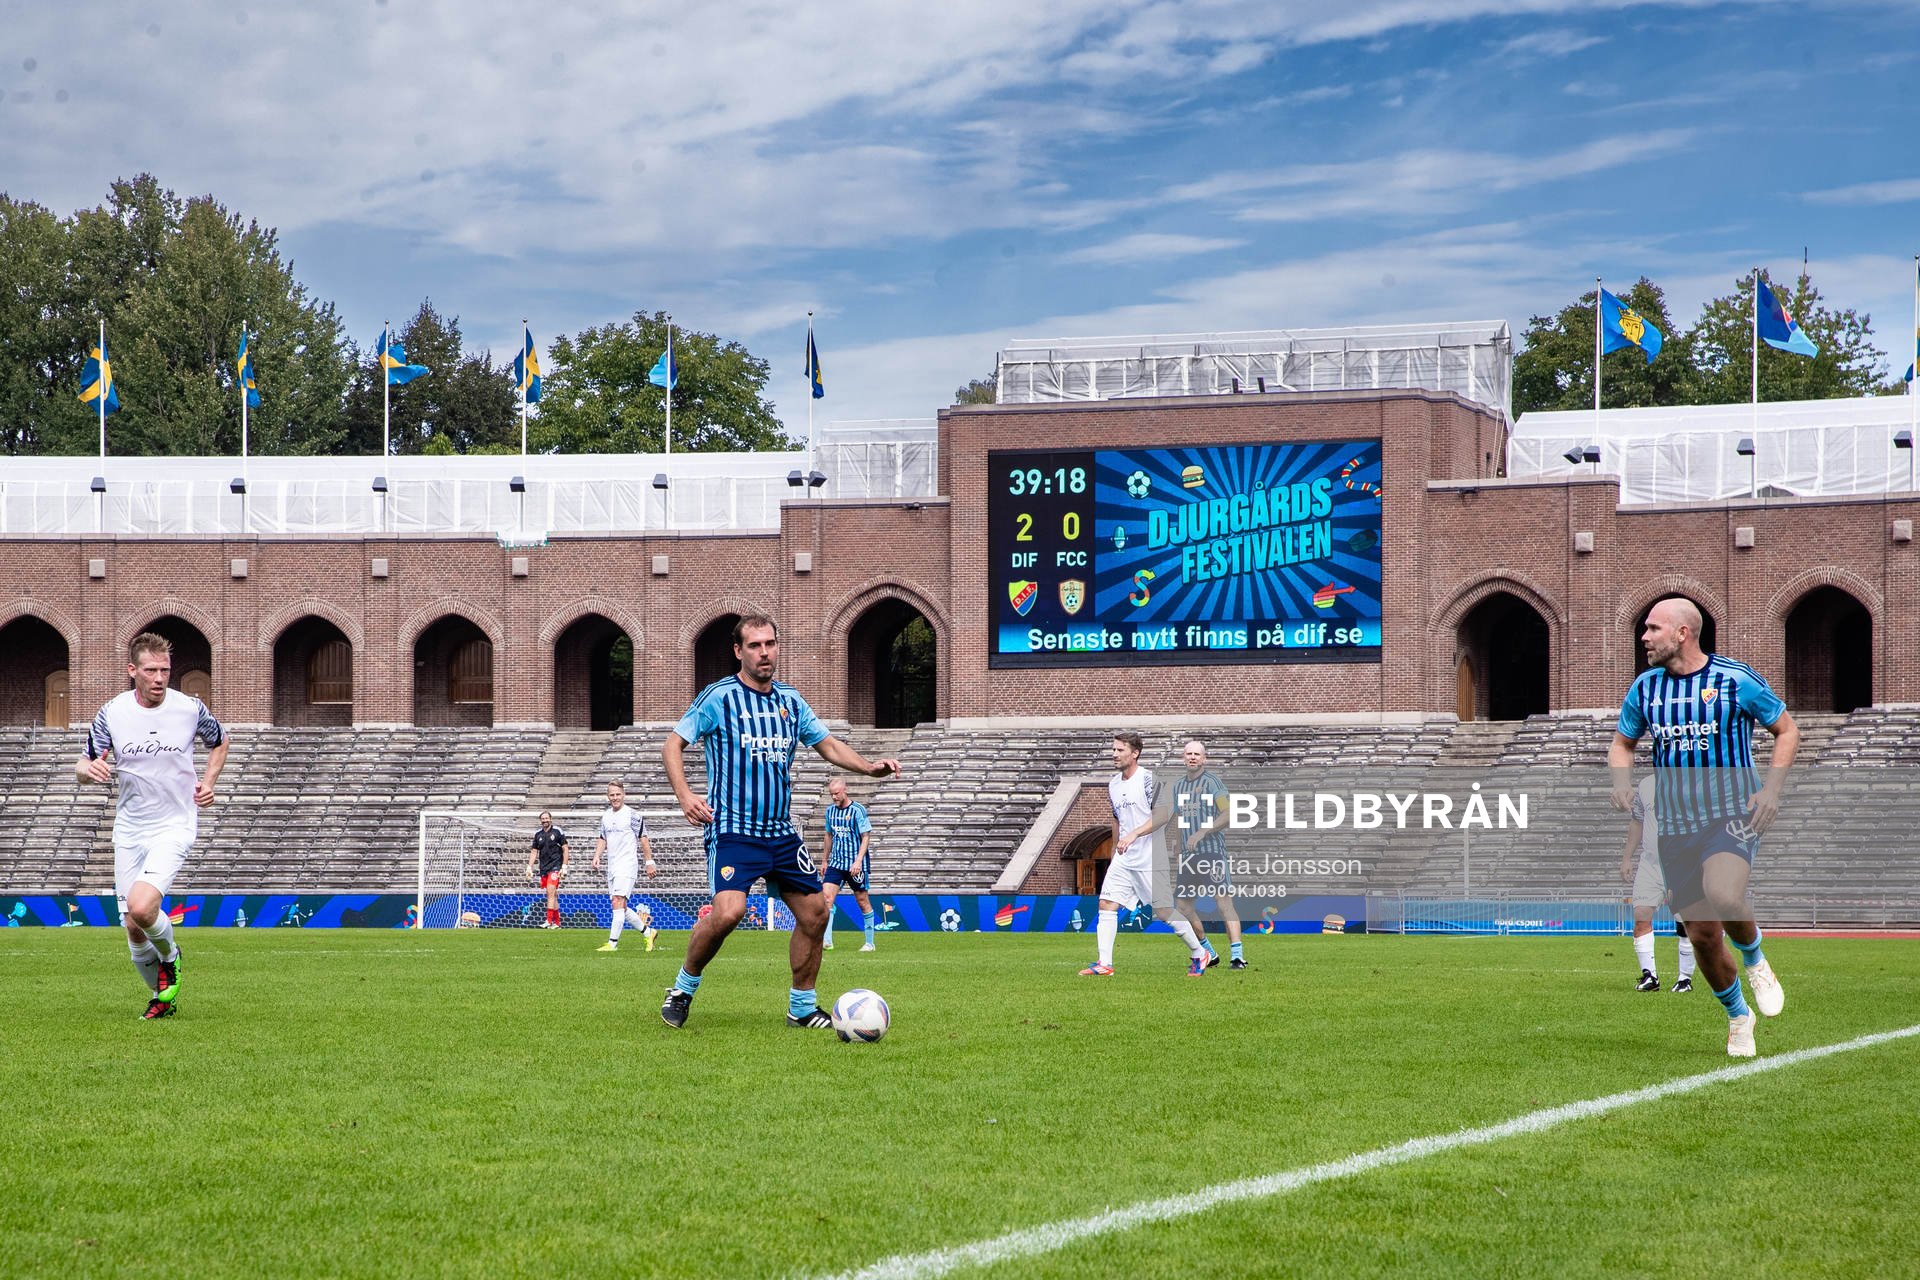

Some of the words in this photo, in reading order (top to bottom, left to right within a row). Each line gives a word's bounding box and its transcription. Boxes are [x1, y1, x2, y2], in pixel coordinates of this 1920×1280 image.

[1009, 467, 1086, 496] 39:18
[1016, 513, 1033, 542] 2
[1063, 512, 1080, 541] 0
[1148, 477, 1333, 550] DJURGÅRDS
[1011, 552, 1039, 568] DIF
[1056, 551, 1088, 567] FCC
[1181, 520, 1333, 585] FESTIVALEN
[1028, 628, 1123, 650] Senaste
[1131, 627, 1178, 650] nytt
[1185, 624, 1248, 648] finns
[1256, 623, 1286, 648] på
[1293, 622, 1364, 646] dif.se
[1651, 720, 1719, 739] Prioritet
[750, 748, 788, 763] Finans
[1661, 737, 1710, 752] Finans
